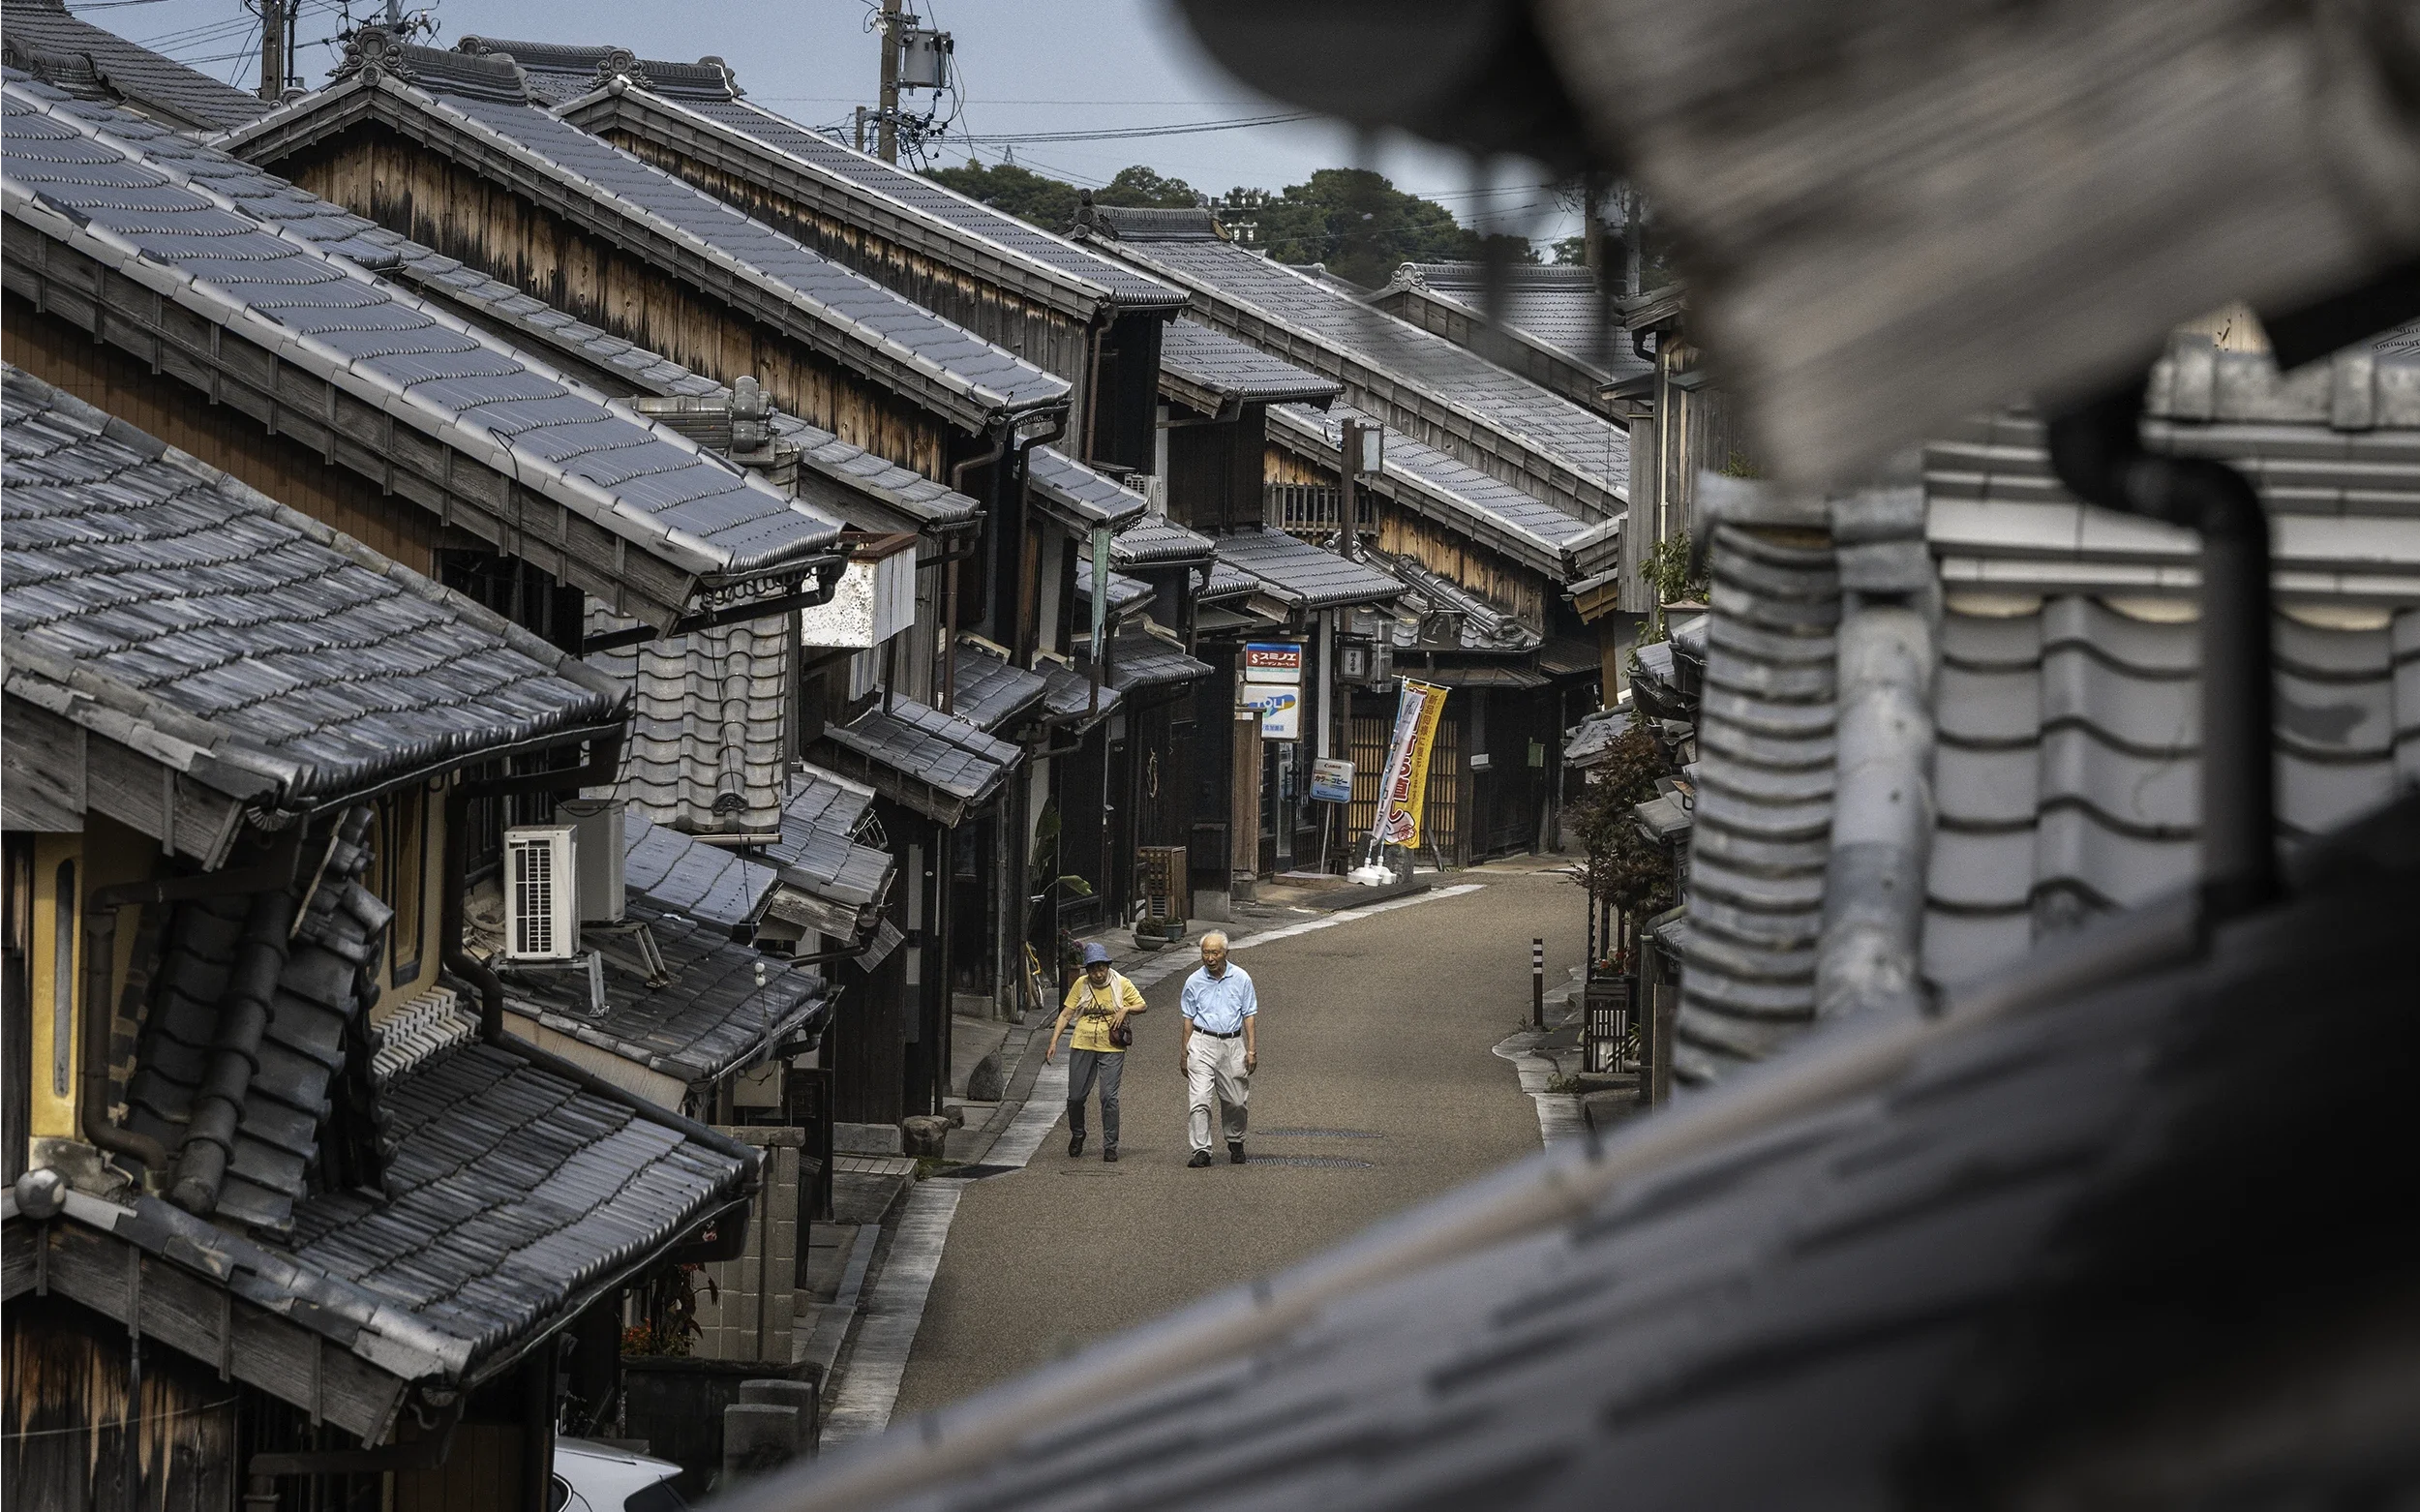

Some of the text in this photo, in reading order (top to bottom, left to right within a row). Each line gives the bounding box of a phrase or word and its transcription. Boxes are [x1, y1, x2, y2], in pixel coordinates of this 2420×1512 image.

[1259, 652, 1297, 661] スミノエ
[1315, 774, 1348, 785] カラーコピー
